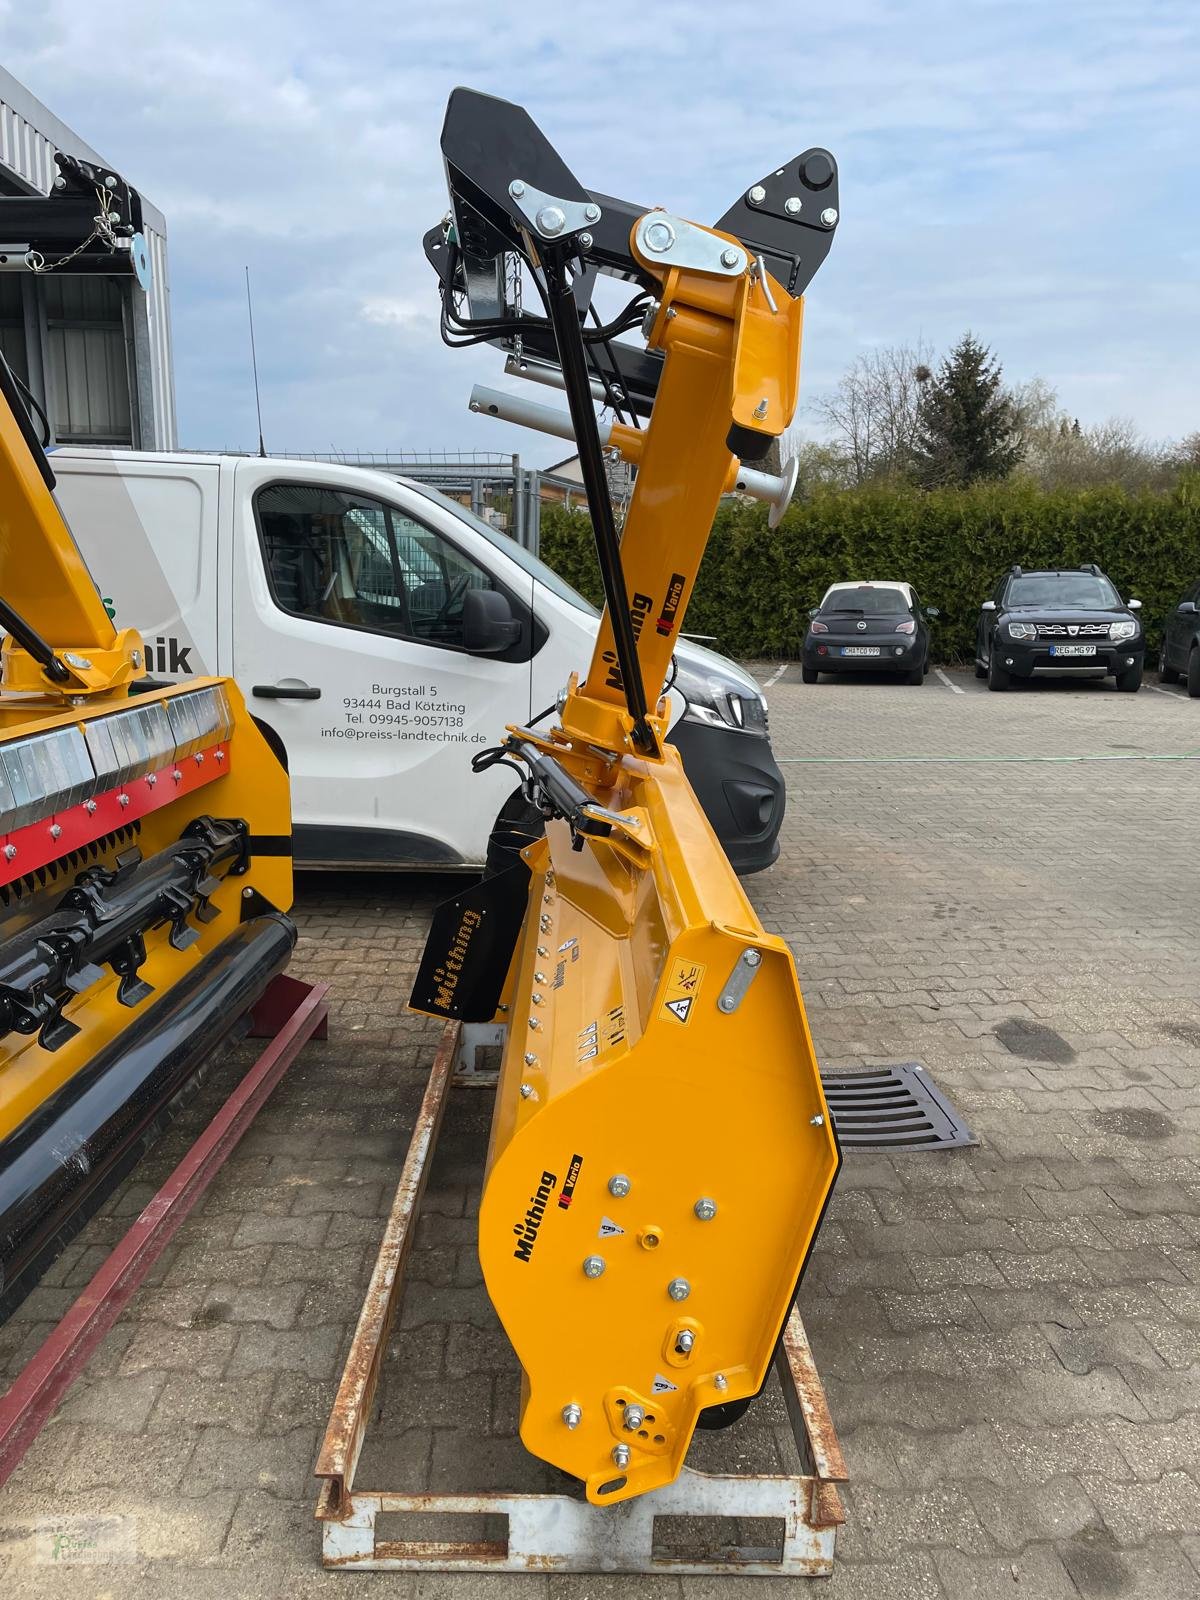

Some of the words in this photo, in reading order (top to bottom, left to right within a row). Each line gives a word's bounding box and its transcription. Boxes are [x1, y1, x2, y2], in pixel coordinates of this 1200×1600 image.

[665, 582, 682, 612] Vario
[1056, 646, 1070, 654] REG
[1074, 646, 1085, 654] MG
[1086, 646, 1095, 654] 97
[372, 684, 425, 697] Burgstall
[430, 686, 438, 696] 5
[343, 698, 382, 709] 93444
[386, 700, 411, 711] Bad
[415, 701, 466, 715] Kötzting
[345, 713, 364, 724] Tel.
[369, 715, 464, 727] 09945-9057138
[321, 727, 487, 743] info@preiss-landtechnik.de
[566, 1162, 581, 1188] Vario
[513, 1170, 558, 1263] Müthing
